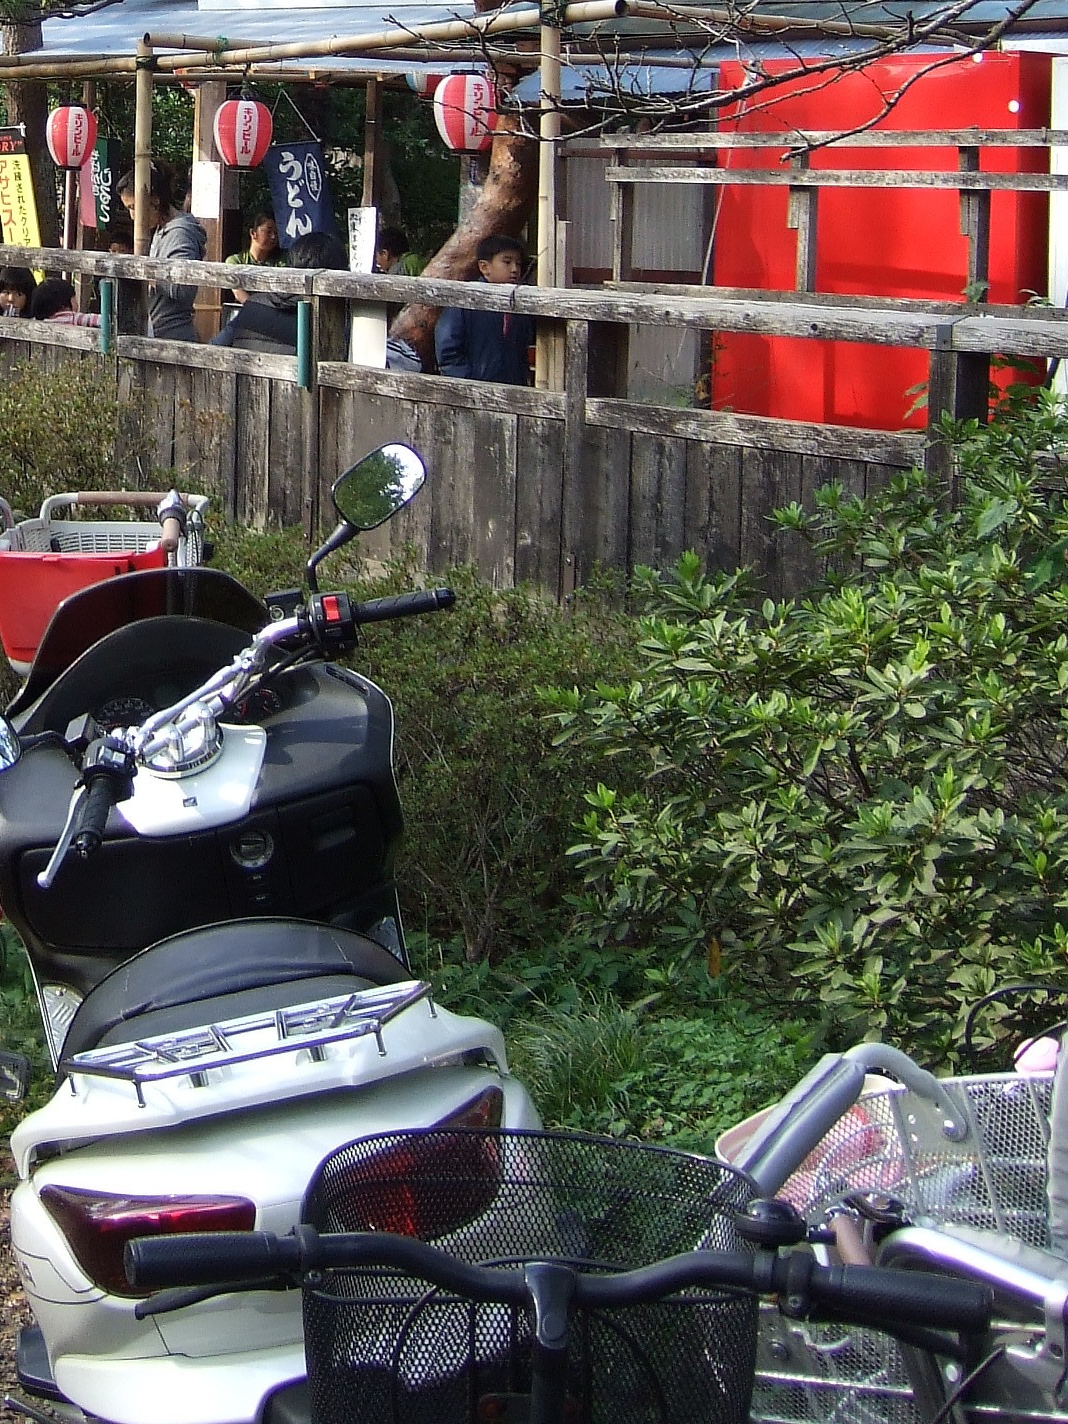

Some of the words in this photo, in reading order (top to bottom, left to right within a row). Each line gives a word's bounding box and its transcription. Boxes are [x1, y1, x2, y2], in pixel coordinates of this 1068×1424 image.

[241, 108, 253, 155] キリンビール
[279, 151, 312, 238] うどん
